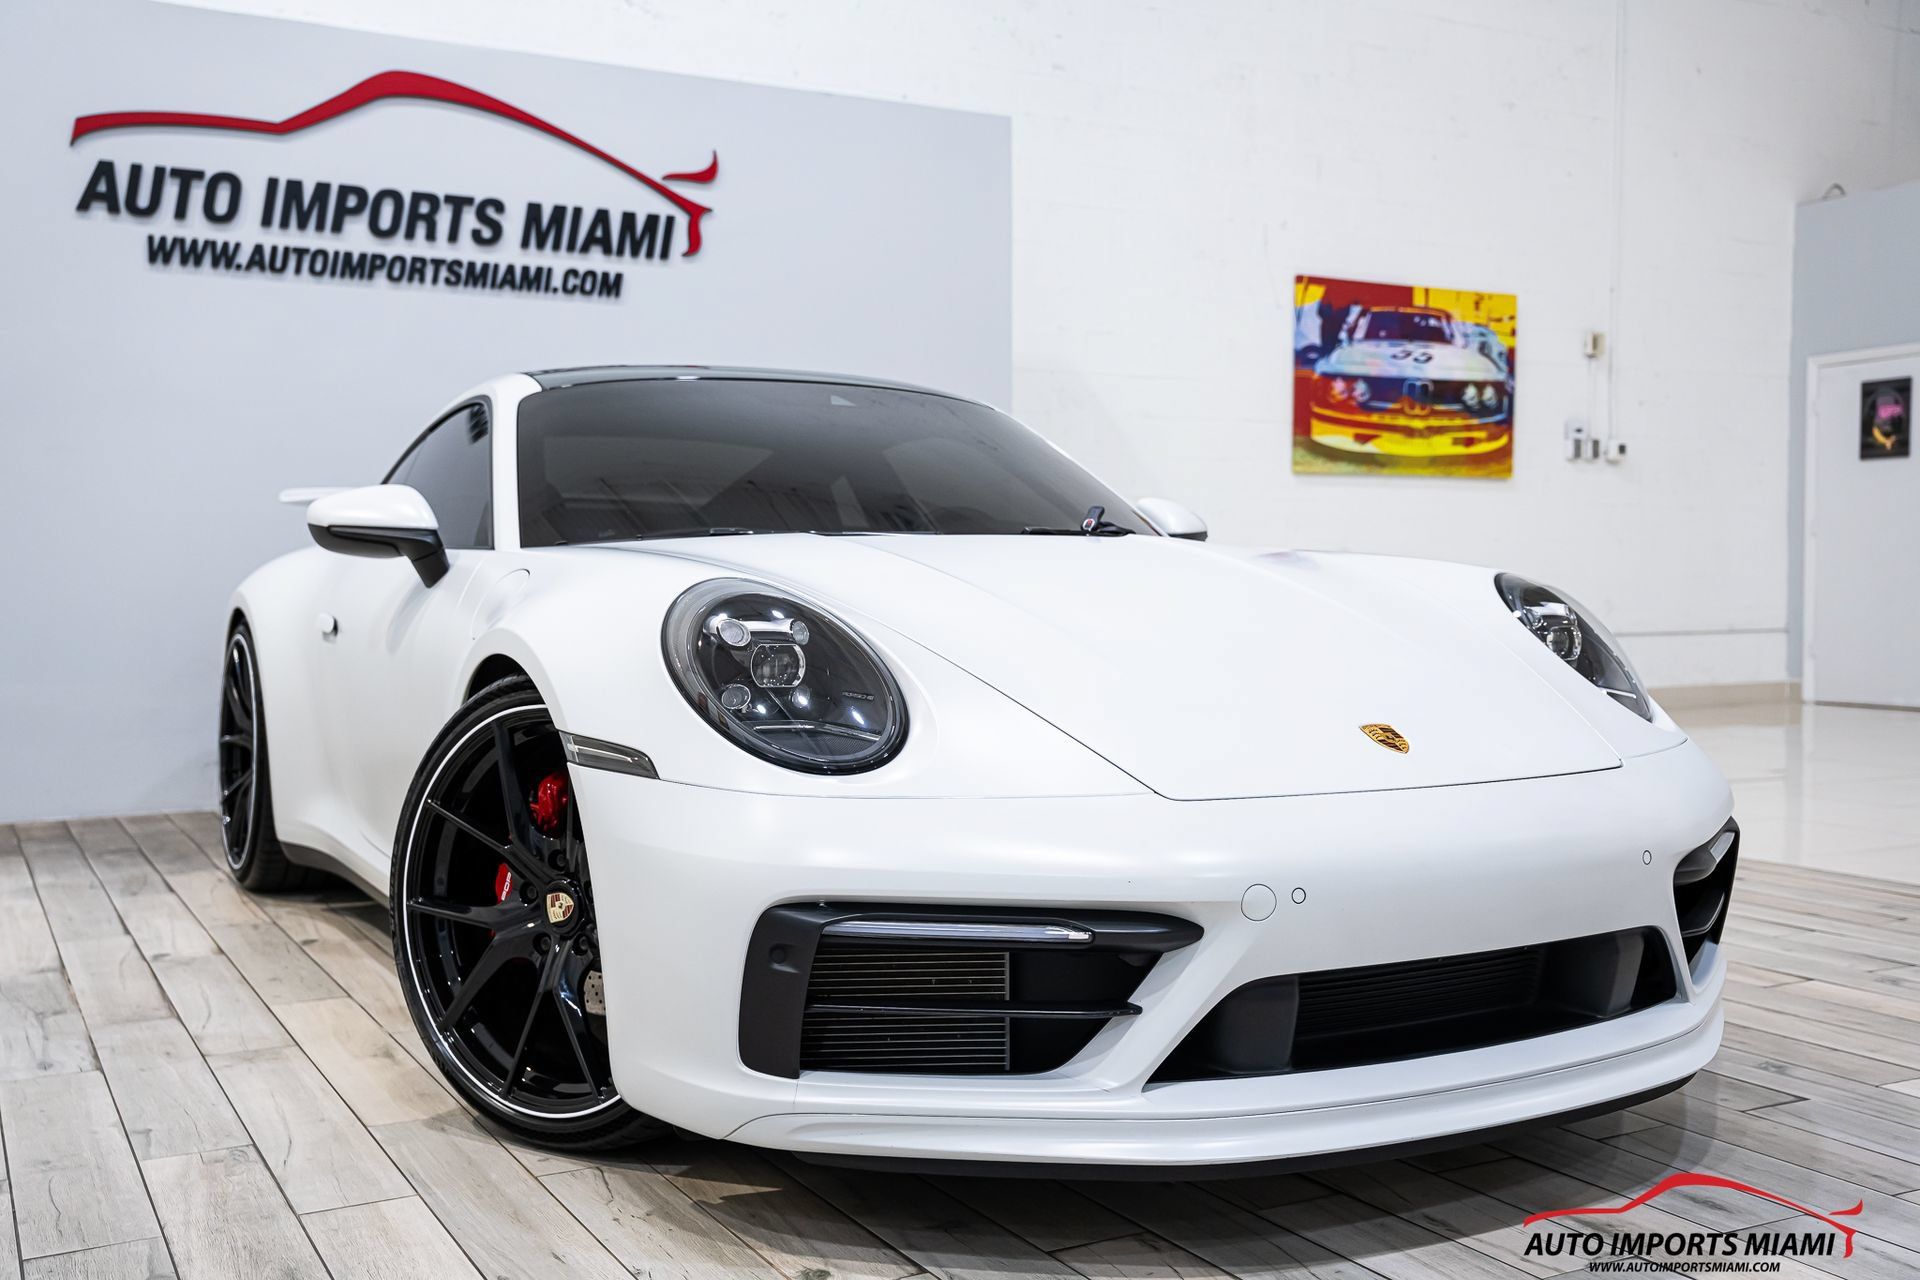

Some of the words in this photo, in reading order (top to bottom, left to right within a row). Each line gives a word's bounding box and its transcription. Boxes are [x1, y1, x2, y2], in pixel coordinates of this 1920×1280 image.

[76, 159, 242, 225] AUTO
[260, 177, 505, 247] IMPORTS
[520, 202, 676, 261] MIAMI
[147, 234, 623, 298] WWW.AUTOIMPORTSMIAMI.COM
